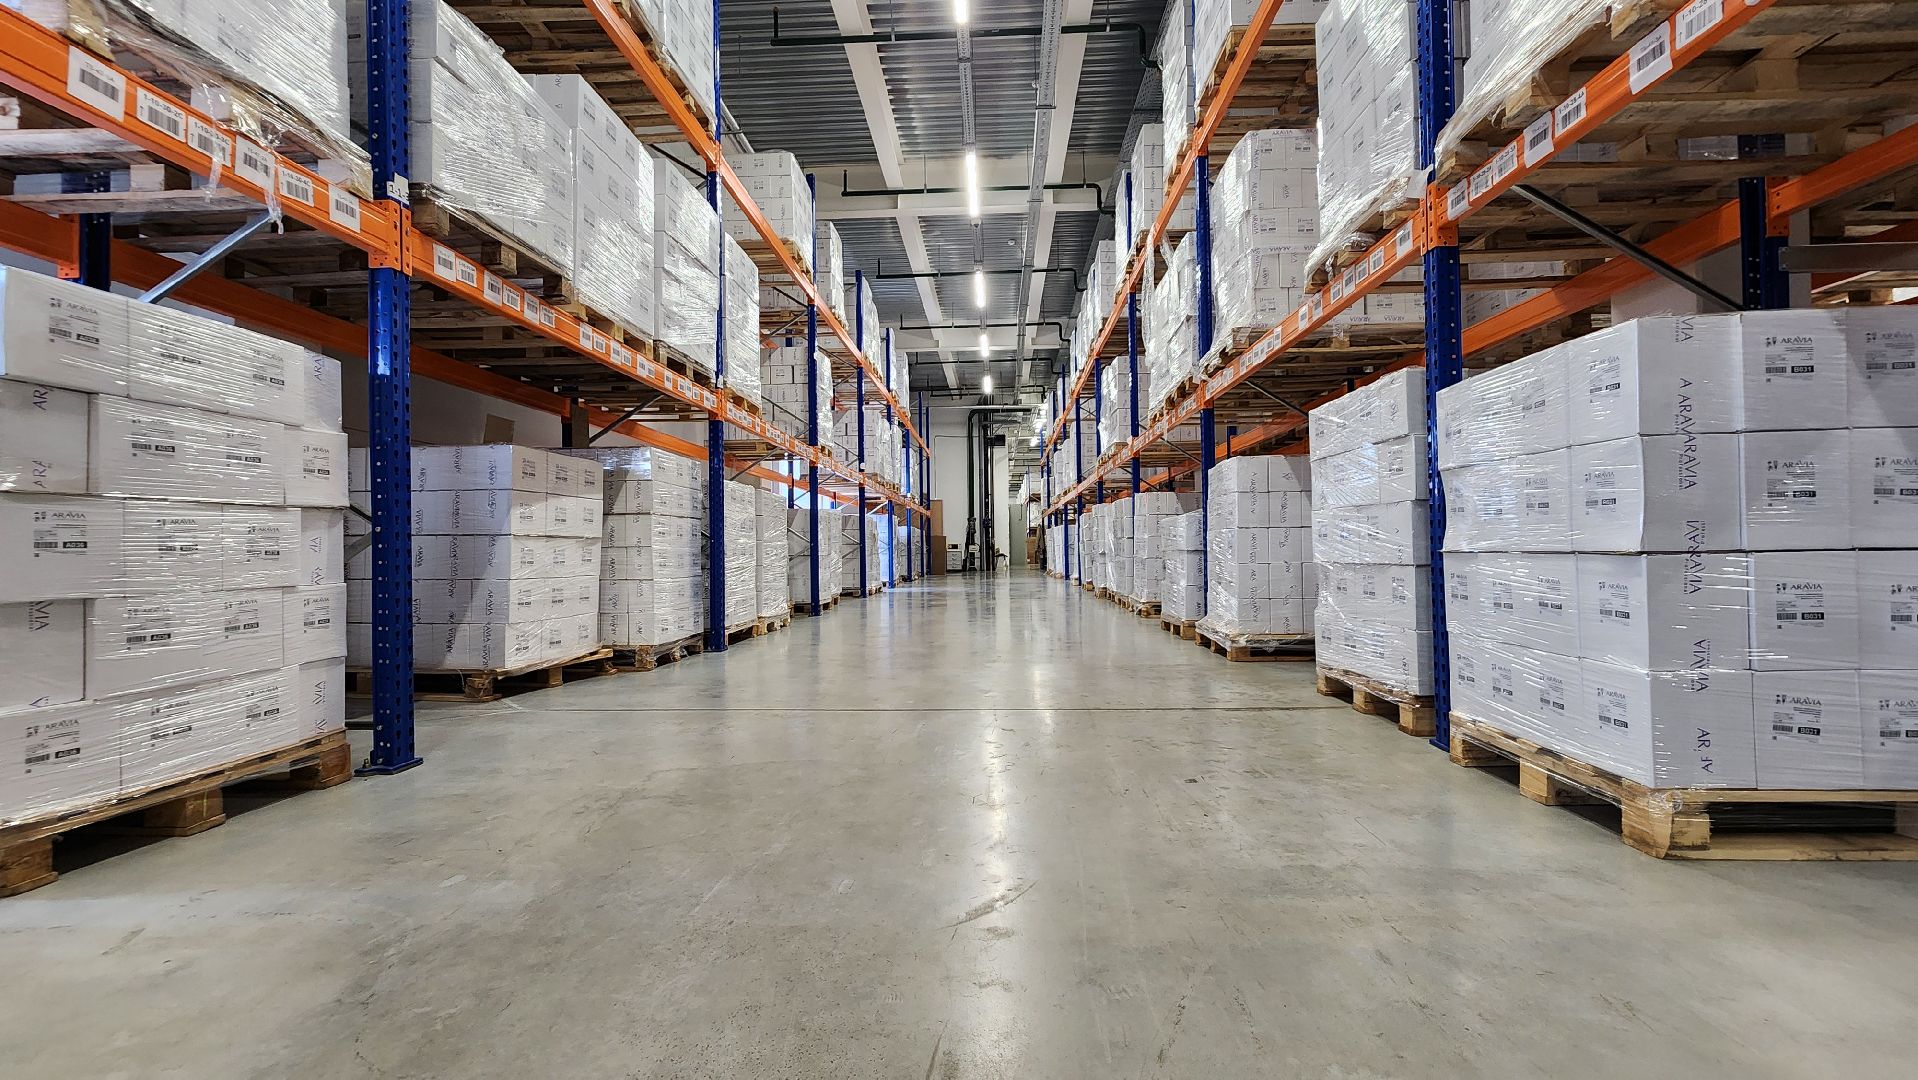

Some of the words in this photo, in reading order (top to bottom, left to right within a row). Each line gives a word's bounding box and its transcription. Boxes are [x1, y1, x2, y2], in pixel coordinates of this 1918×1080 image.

[1780, 336, 1813, 344] ARAVIA
[1683, 434, 1701, 489] ARAVIA
[1594, 471, 1614, 479] ARAVIA
[1608, 583, 1628, 591] ARAVIA
[1790, 582, 1823, 590] ARAVIA
[1790, 697, 1822, 706] ARAVIA
[45, 719, 80, 730] ARAVIA
